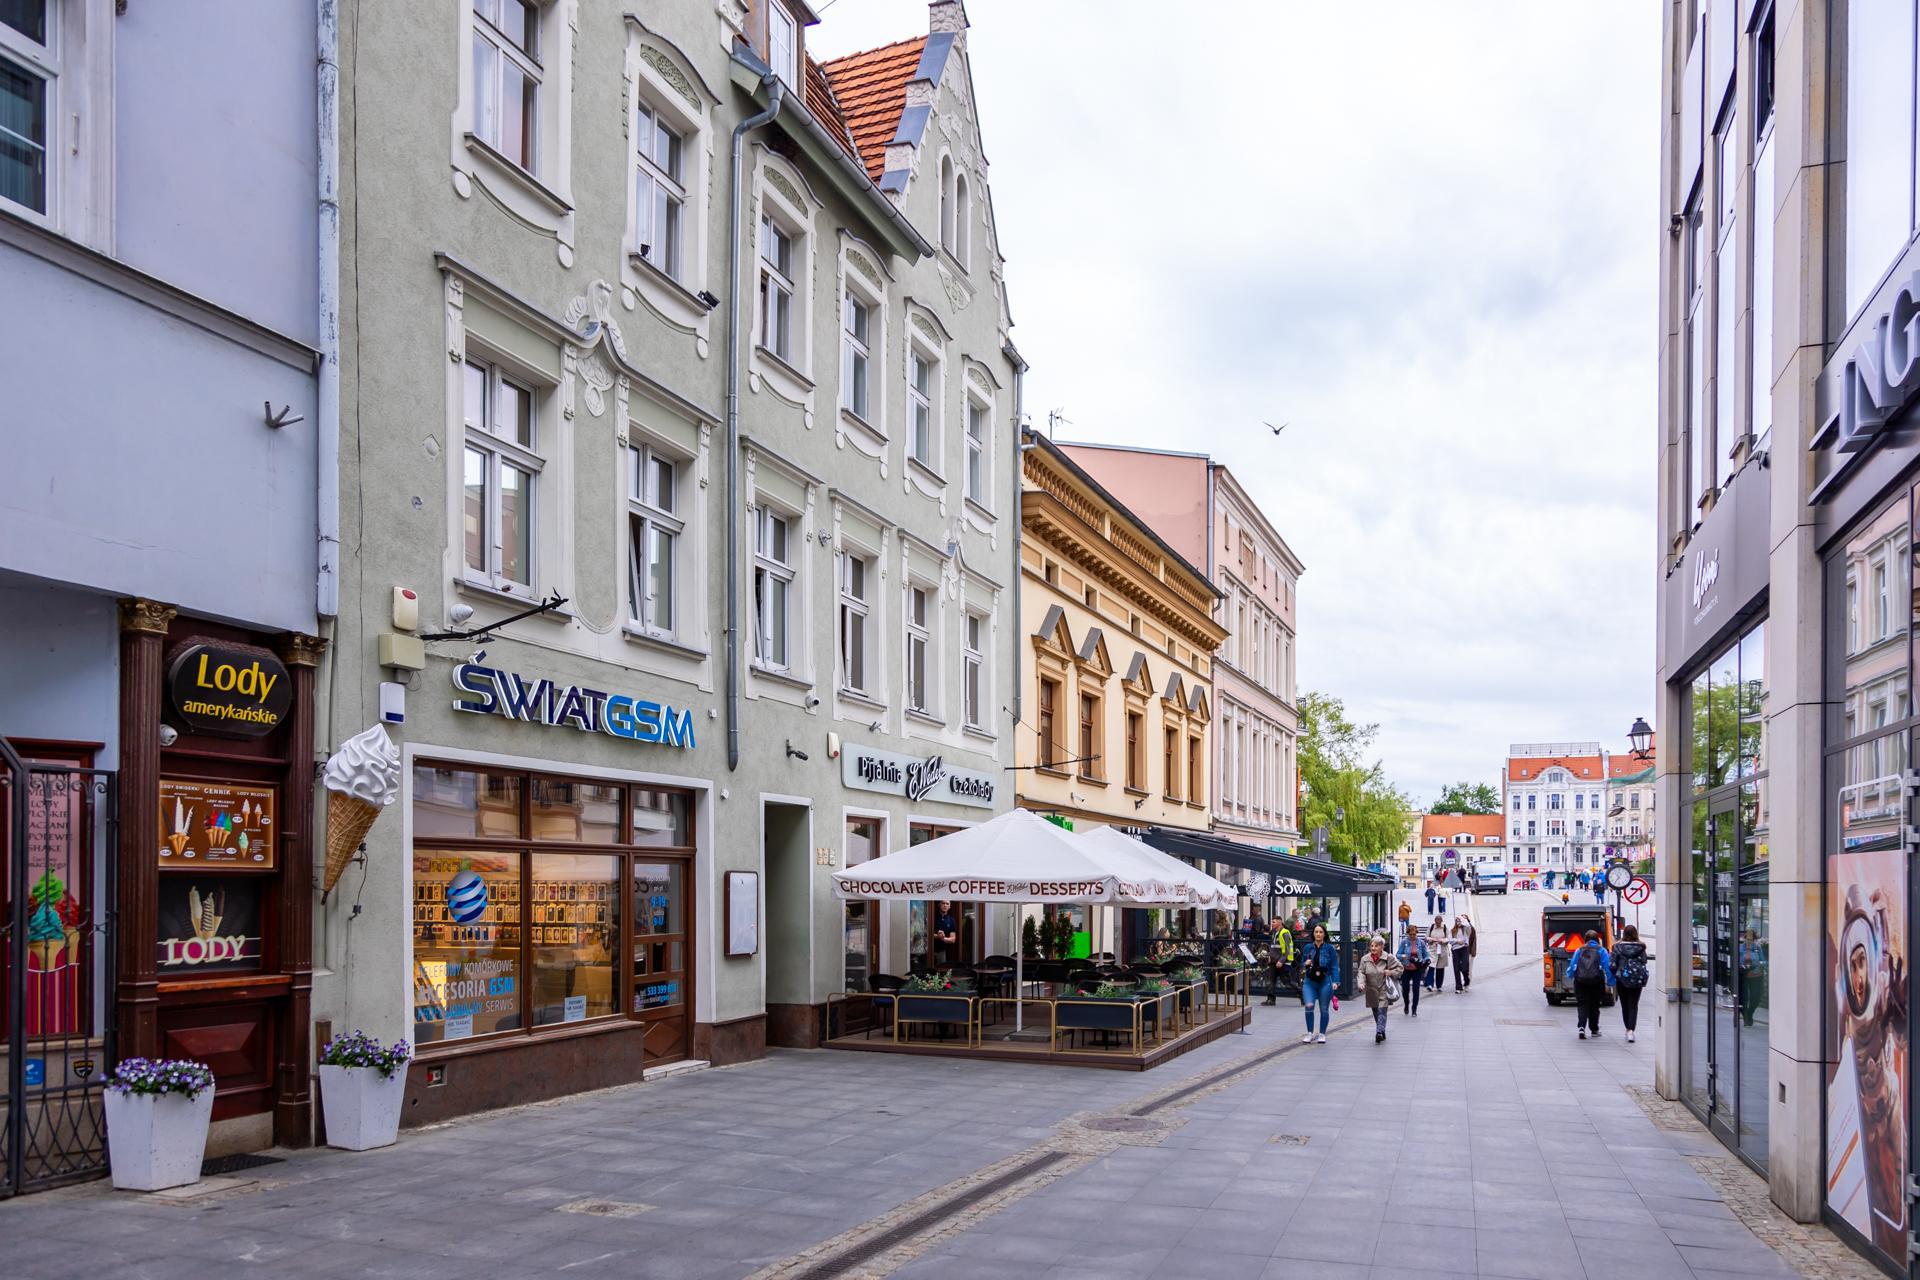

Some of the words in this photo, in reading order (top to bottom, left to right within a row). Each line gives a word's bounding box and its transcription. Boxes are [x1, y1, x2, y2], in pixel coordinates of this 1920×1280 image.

[197, 654, 277, 703] Lody
[183, 700, 277, 725] amerykańskie
[858, 756, 902, 783] Pijalnia
[950, 775, 994, 801] Czekolady
[203, 788, 231, 796] CENNIK
[840, 881, 925, 894] CHOCOLATE
[948, 881, 1006, 894] COFFEE
[1029, 882, 1104, 896] DESSERTS
[163, 935, 246, 966] LODY
[464, 959, 514, 975] KOMÓRKOWE
[488, 976, 515, 997] GSM
[485, 998, 514, 1013] SERWIS
